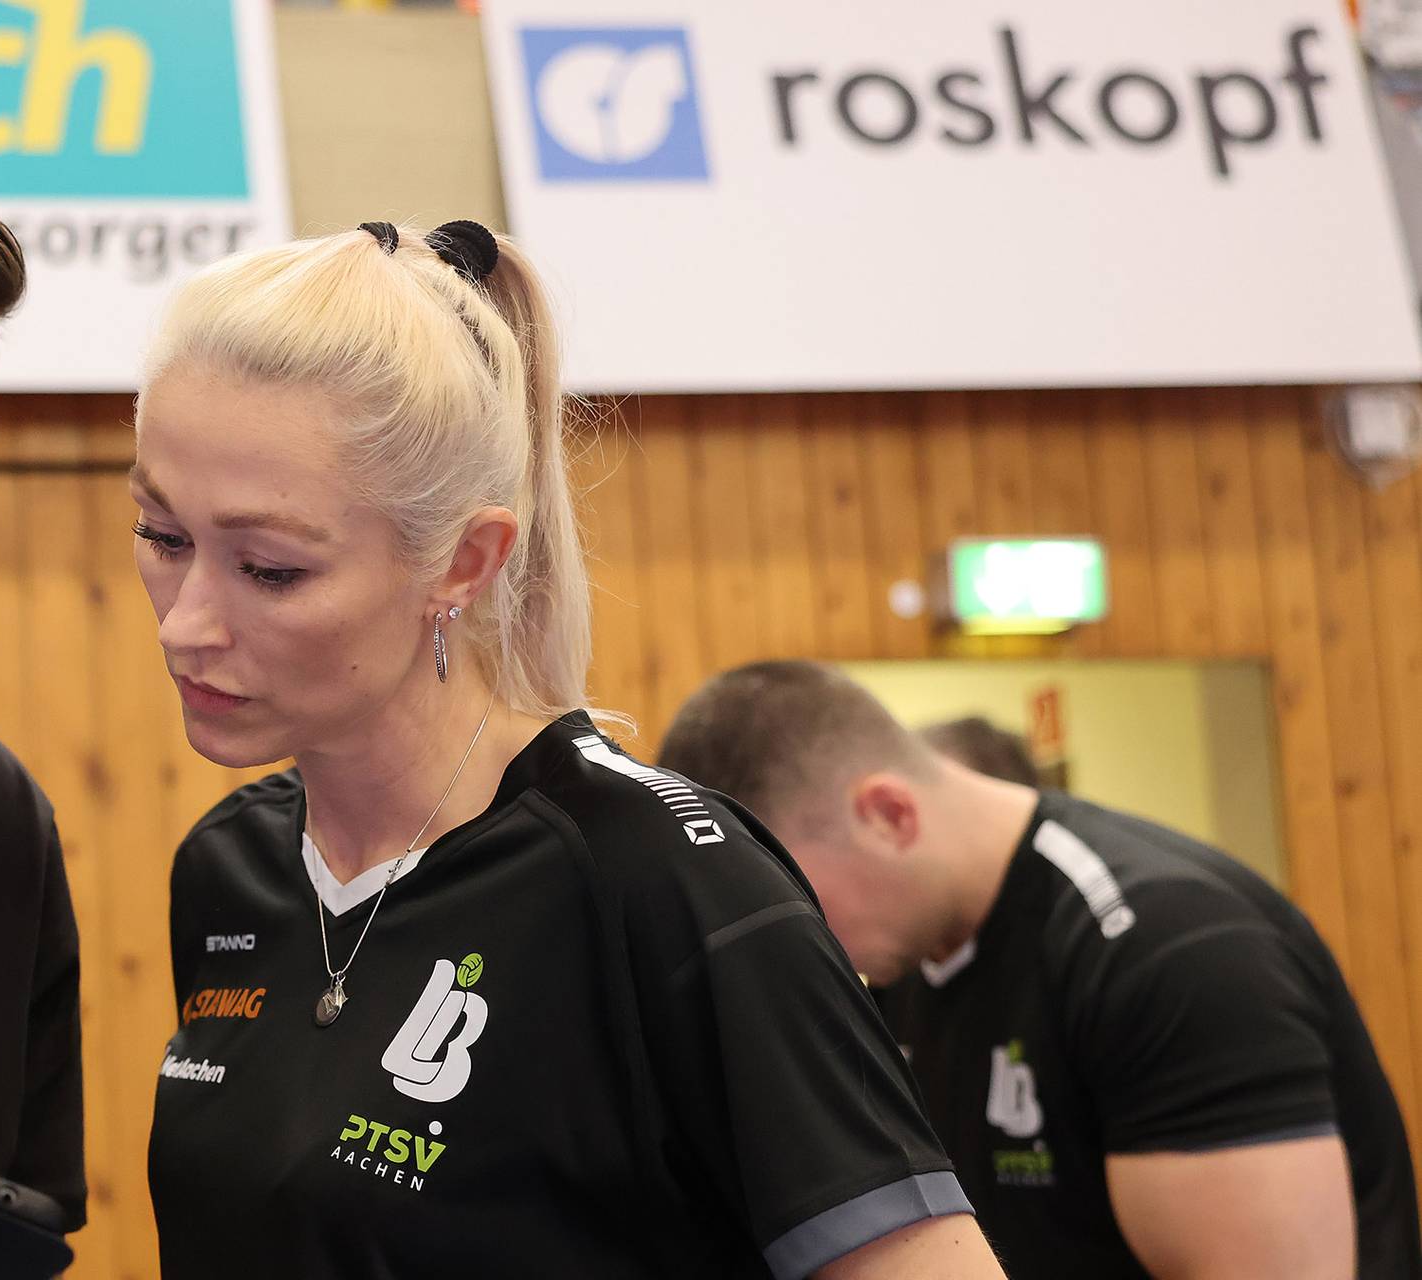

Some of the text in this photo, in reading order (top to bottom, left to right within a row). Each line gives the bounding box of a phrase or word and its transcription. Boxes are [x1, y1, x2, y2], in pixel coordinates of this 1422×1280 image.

[769, 23, 1332, 182] roskopf
[206, 934, 256, 952] STANNO
[331, 1146, 425, 1192] AACHEN
[339, 1114, 446, 1173] PTSV
